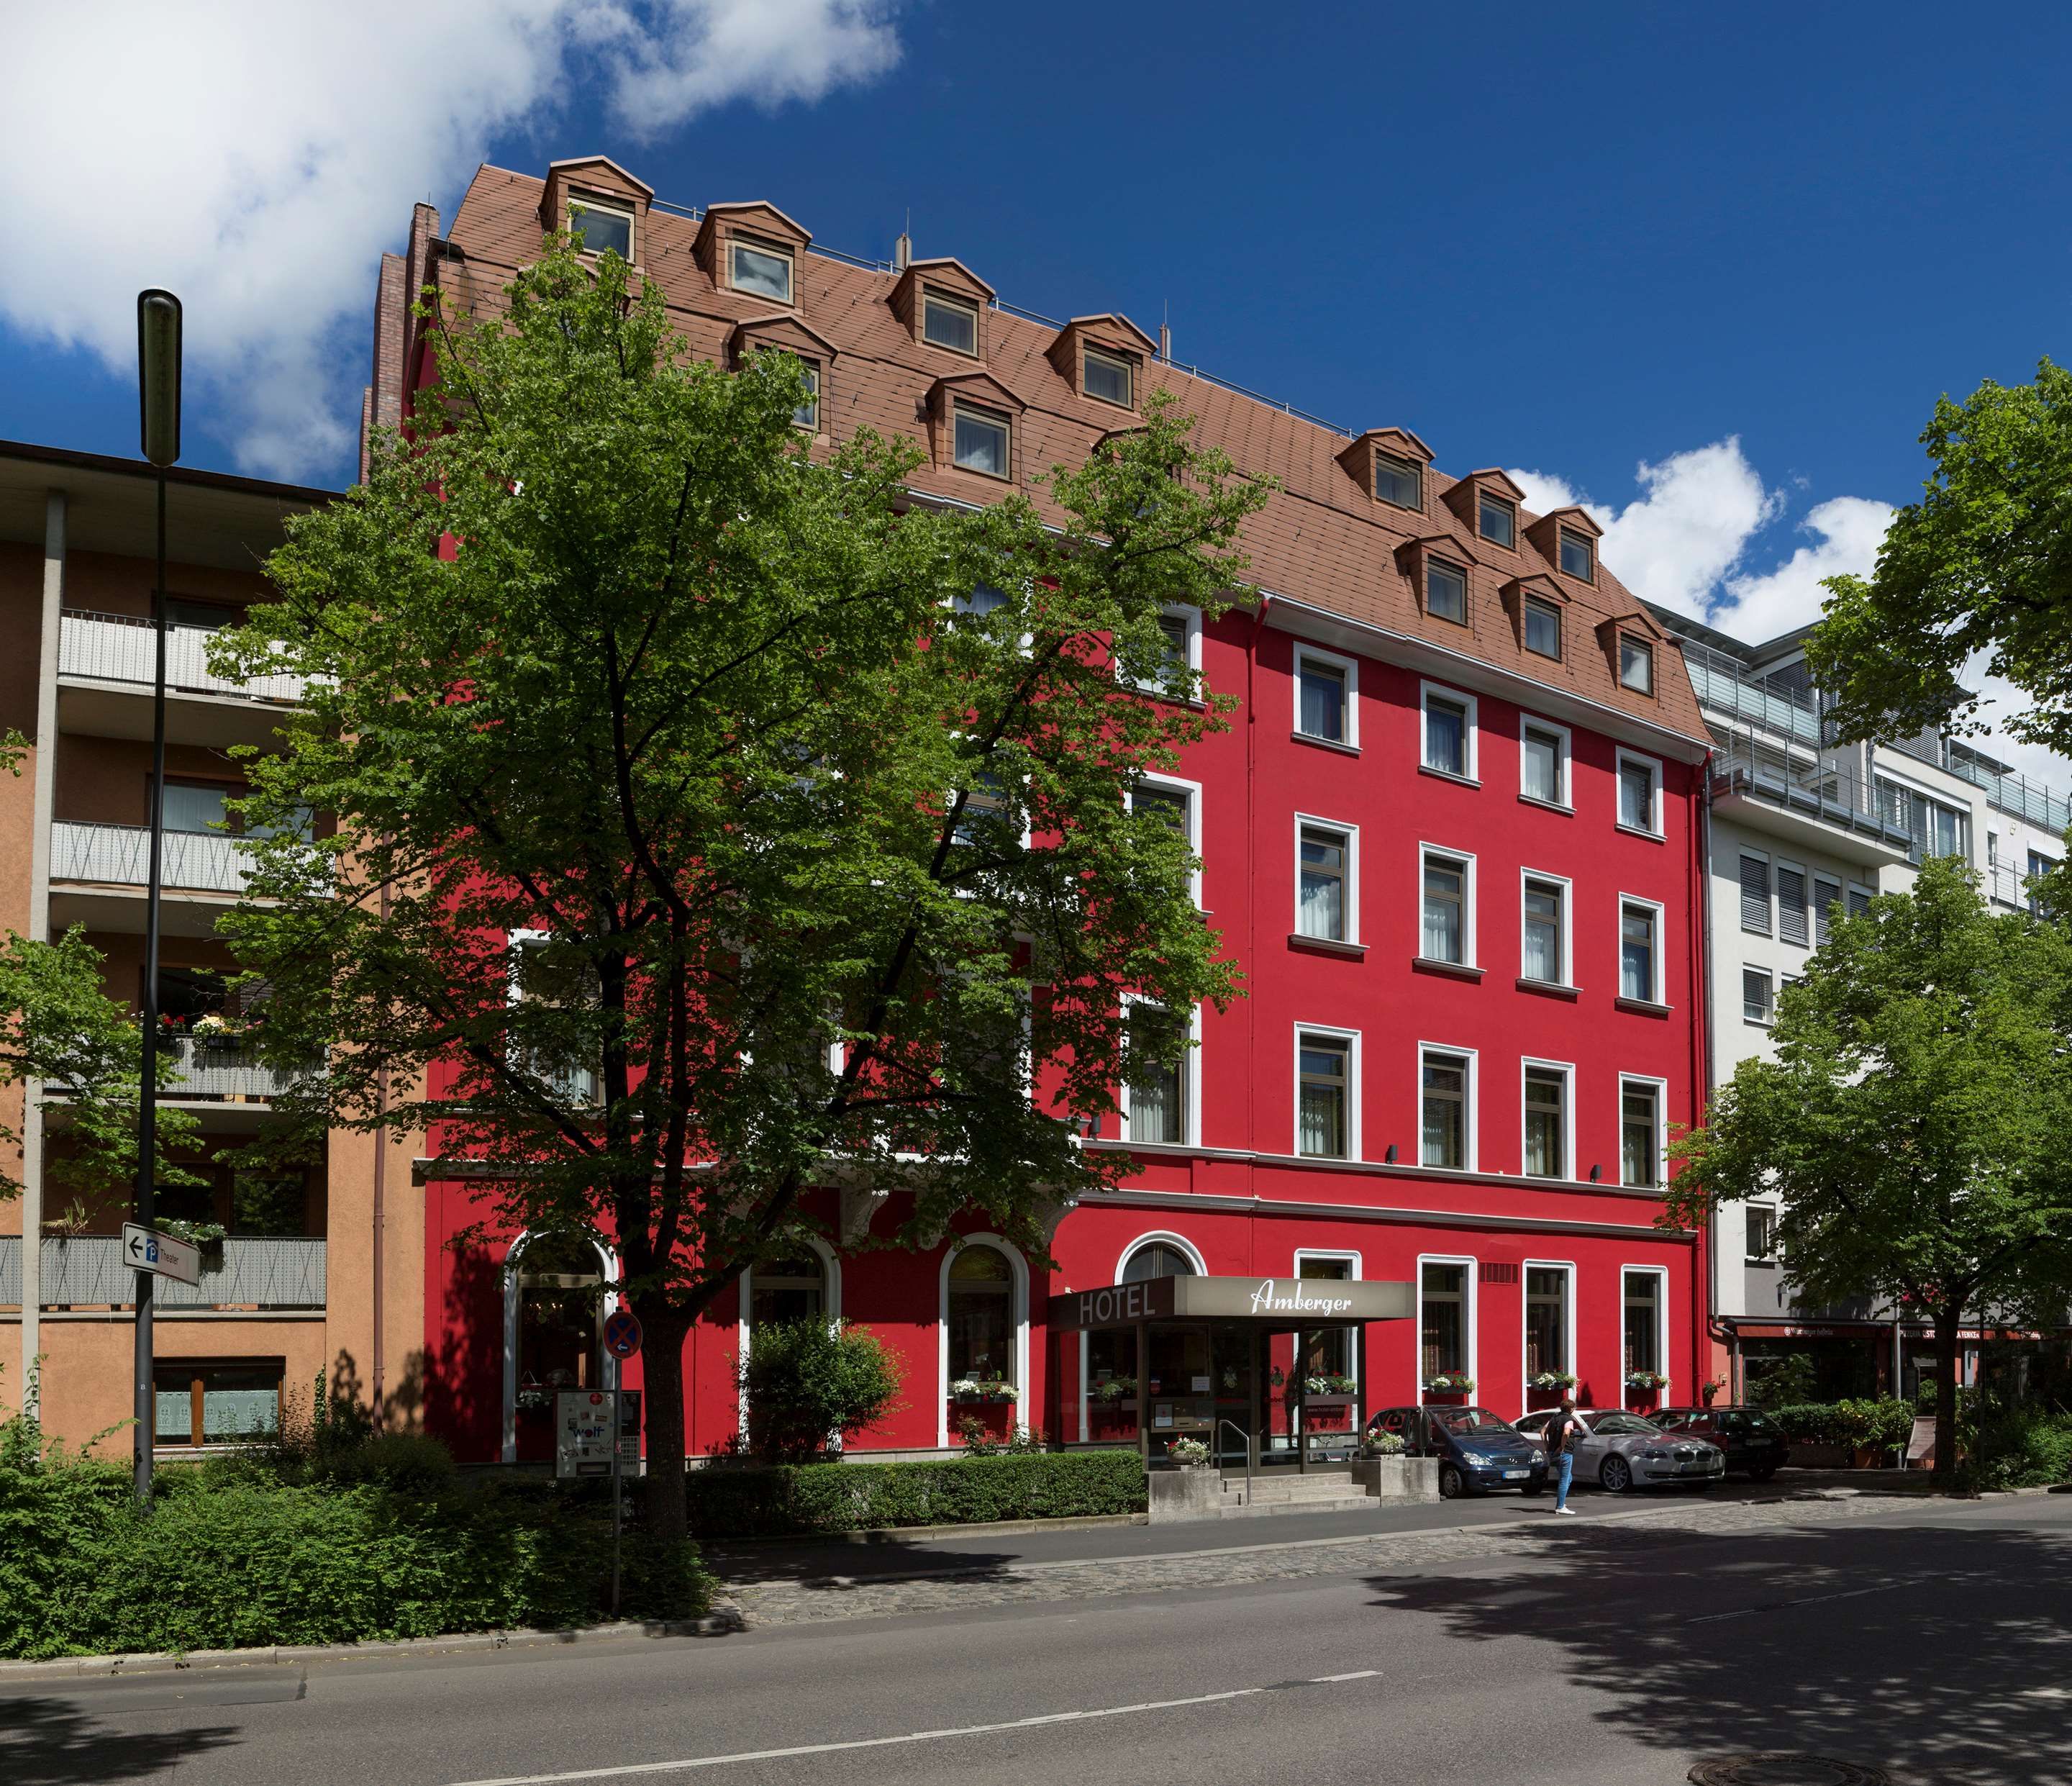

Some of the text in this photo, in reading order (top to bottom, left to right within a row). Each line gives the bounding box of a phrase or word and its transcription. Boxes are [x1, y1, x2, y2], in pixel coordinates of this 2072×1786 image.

[160, 1248, 179, 1266] Theater
[1079, 1283, 1155, 1325] HOTEL
[1250, 1279, 1352, 1317] Amberger
[573, 1426, 605, 1438] wolf
